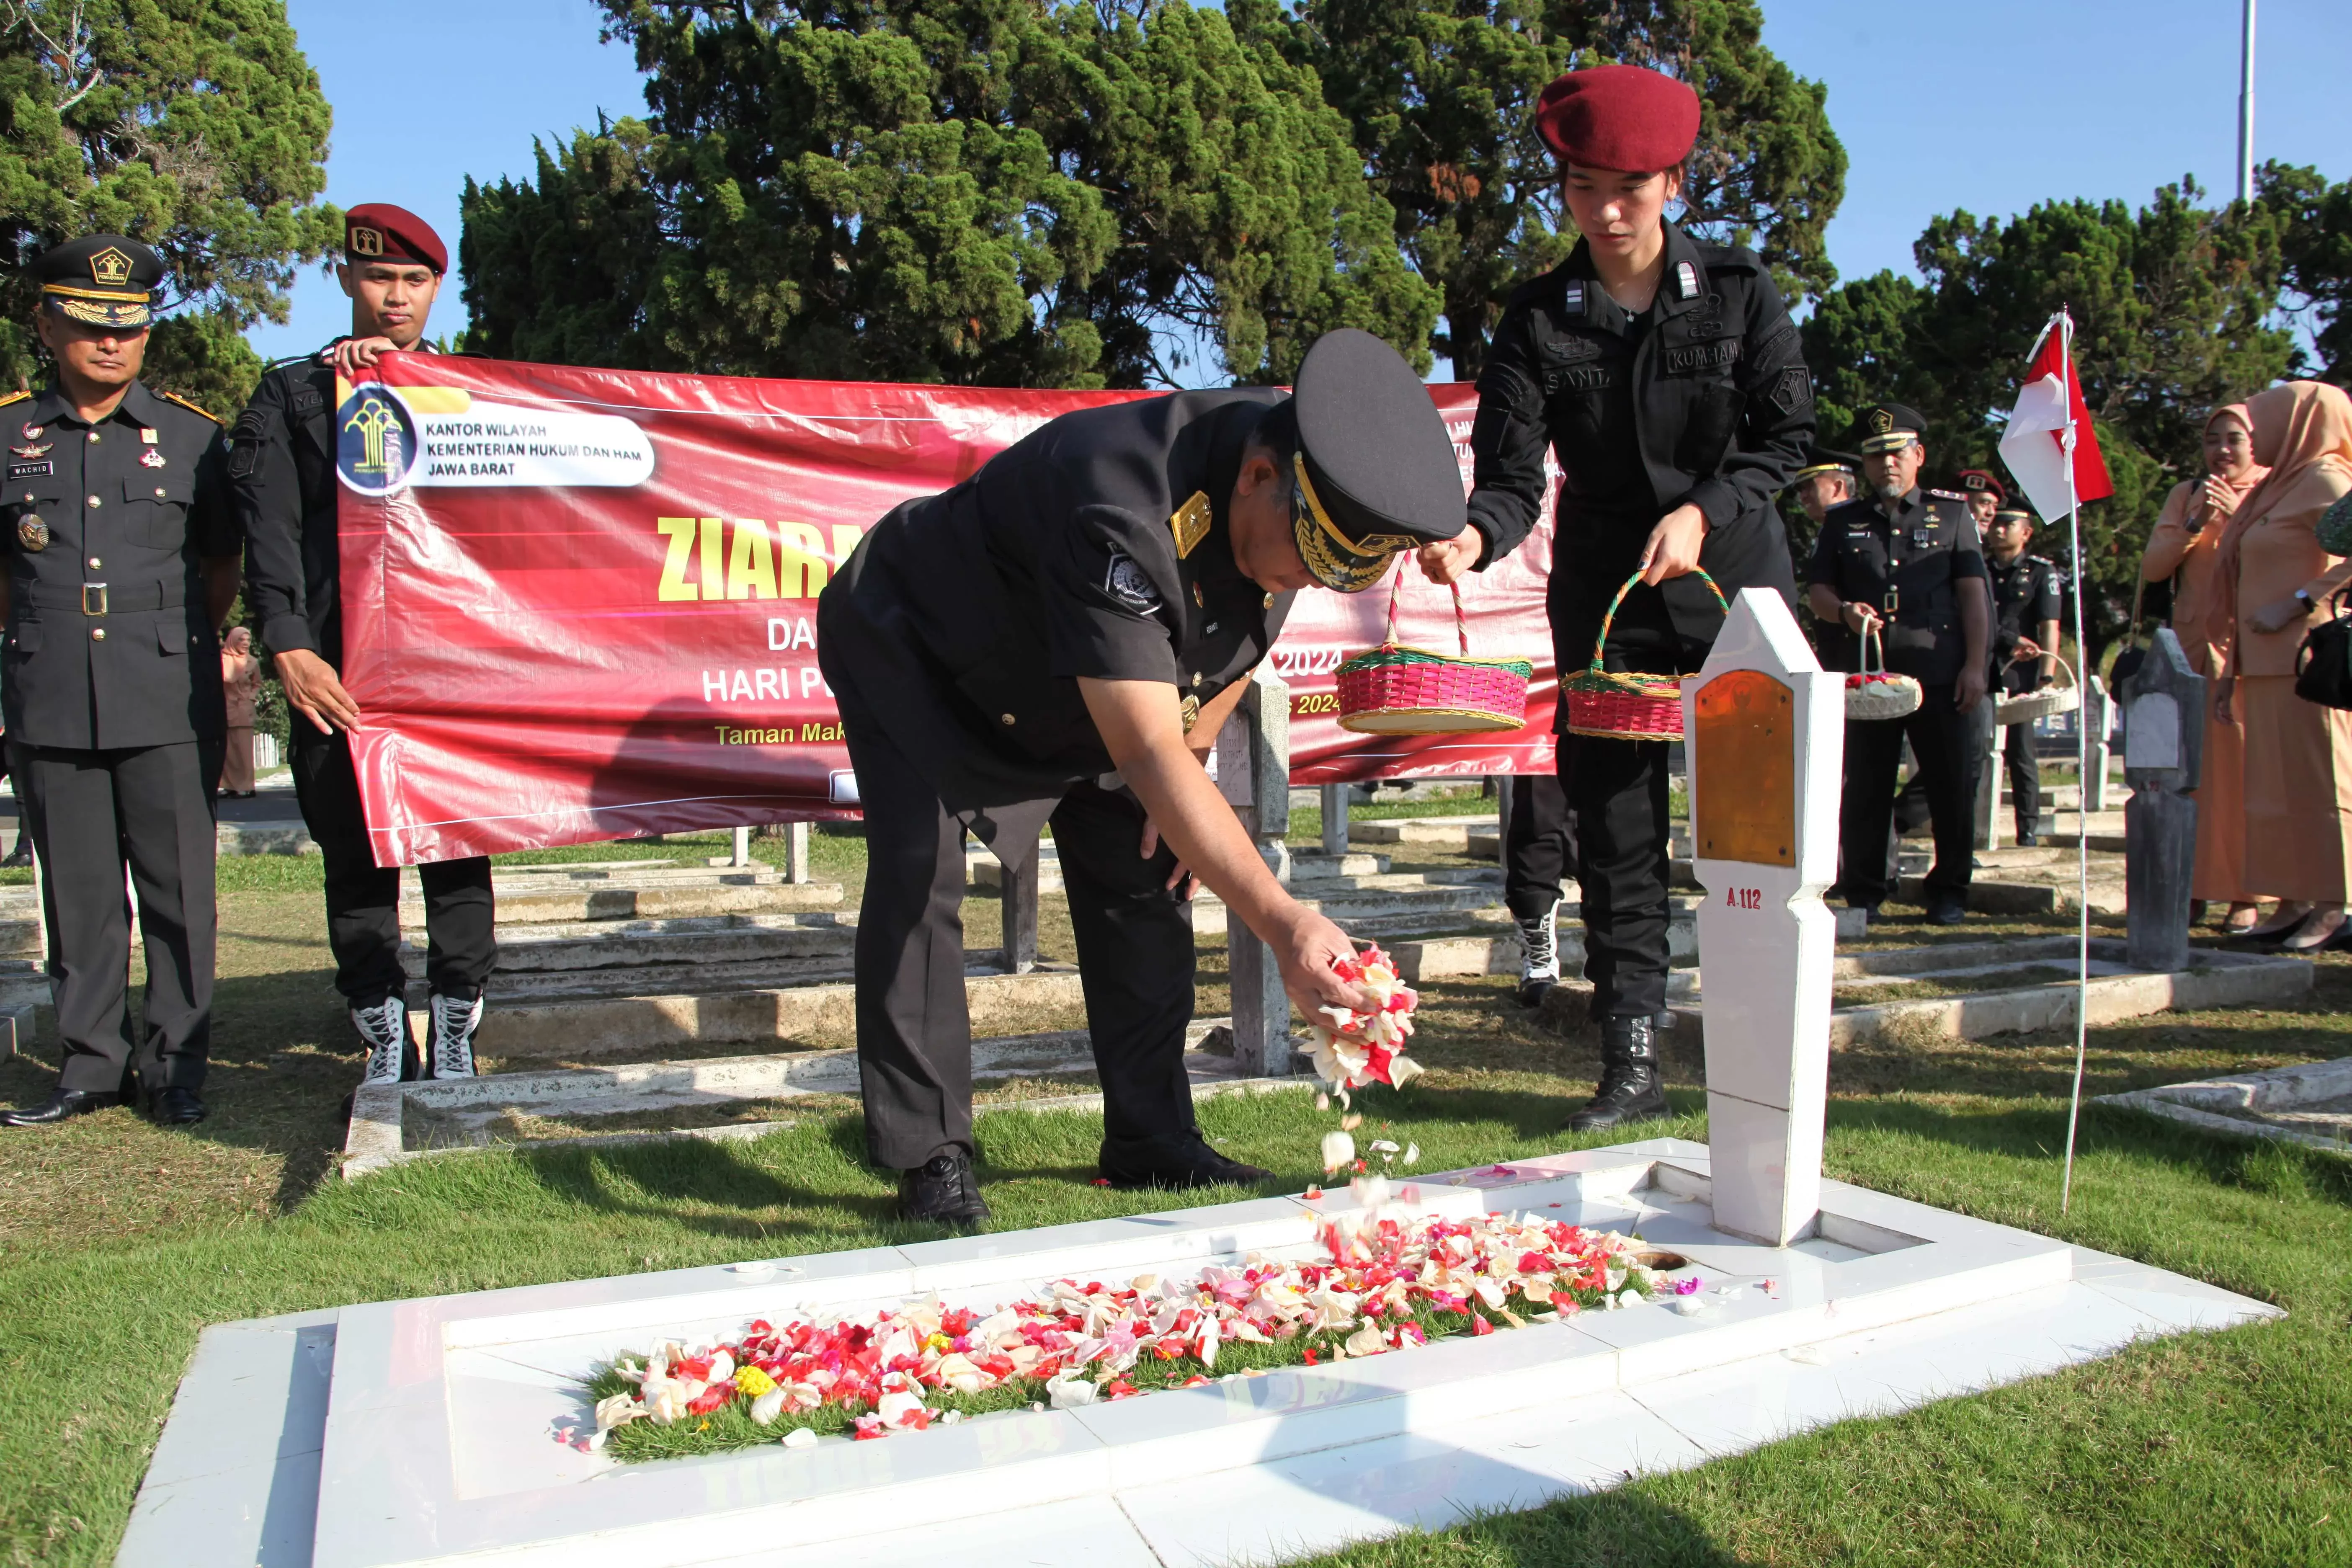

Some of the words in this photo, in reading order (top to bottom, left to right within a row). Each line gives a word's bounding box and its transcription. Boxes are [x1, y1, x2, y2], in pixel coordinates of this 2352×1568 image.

[426, 423, 482, 436] KANTOR
[486, 424, 547, 436] WILAYAH
[427, 443, 525, 456] KEMENTERIAN
[530, 444, 579, 456] HUKUM
[583, 446, 610, 458] DAN
[613, 449, 642, 461] HAM
[15, 466, 46, 474] WACHID
[428, 463, 467, 476] JAWA
[470, 463, 515, 475] BARAT
[768, 617, 816, 650] DA
[702, 668, 789, 702] HARI
[1277, 649, 1342, 677] 2024
[714, 726, 794, 745] Taman
